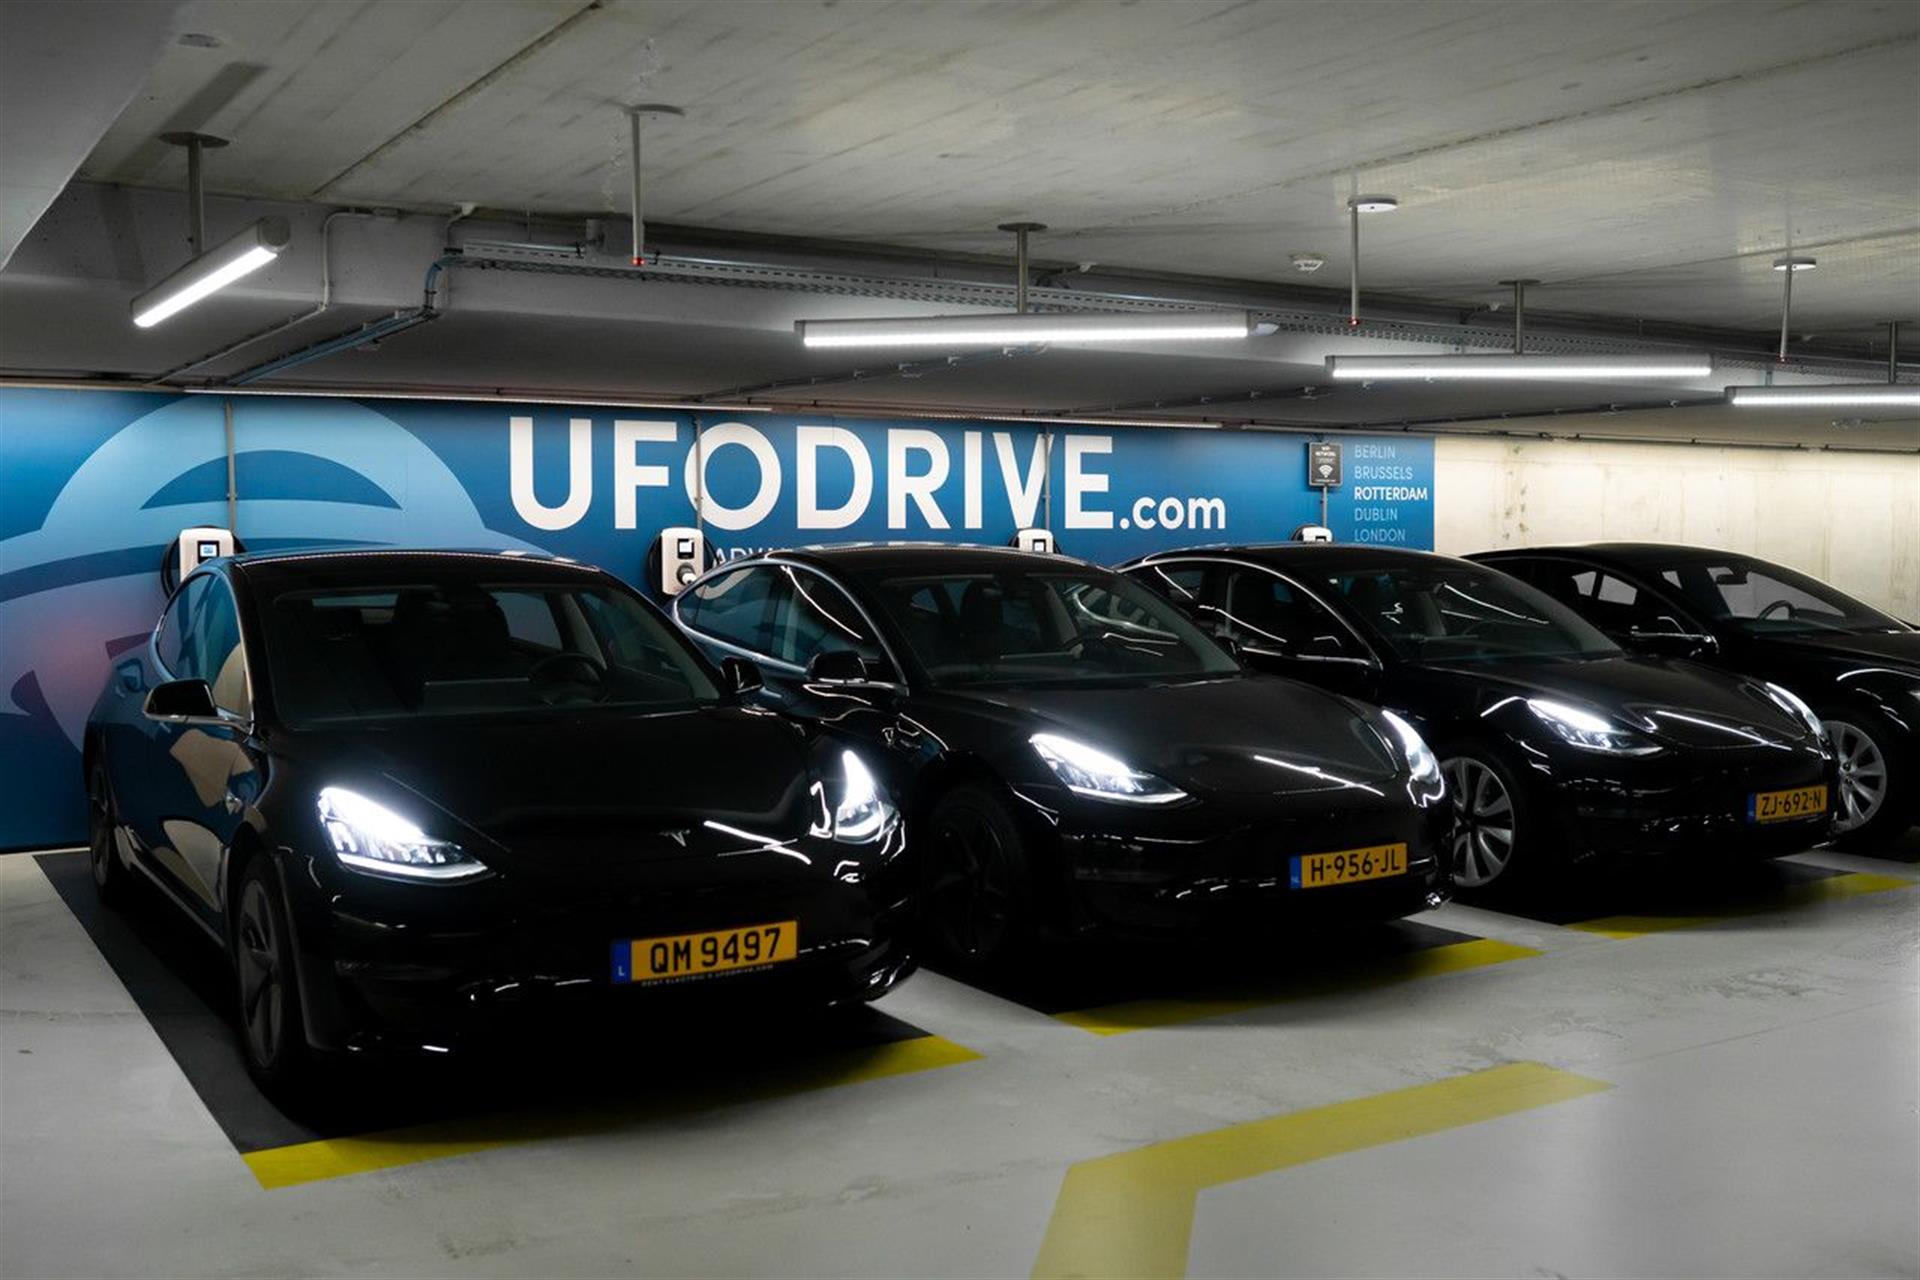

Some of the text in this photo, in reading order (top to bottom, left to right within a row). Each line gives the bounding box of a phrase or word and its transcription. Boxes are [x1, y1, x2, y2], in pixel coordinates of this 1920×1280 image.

[1354, 444, 1396, 458] BERLIN
[509, 416, 1226, 531] UFODRIVE.com
[1354, 465, 1414, 480] BRUSSELS
[1353, 486, 1428, 501] ROTTERDAM
[1354, 507, 1398, 522] DUBLIN
[1354, 527, 1406, 542] LONDON
[1761, 789, 1821, 816] ZJ-692-N
[1310, 848, 1401, 882] H-956-JL
[650, 938, 692, 974] QM
[700, 927, 782, 968] 9497
